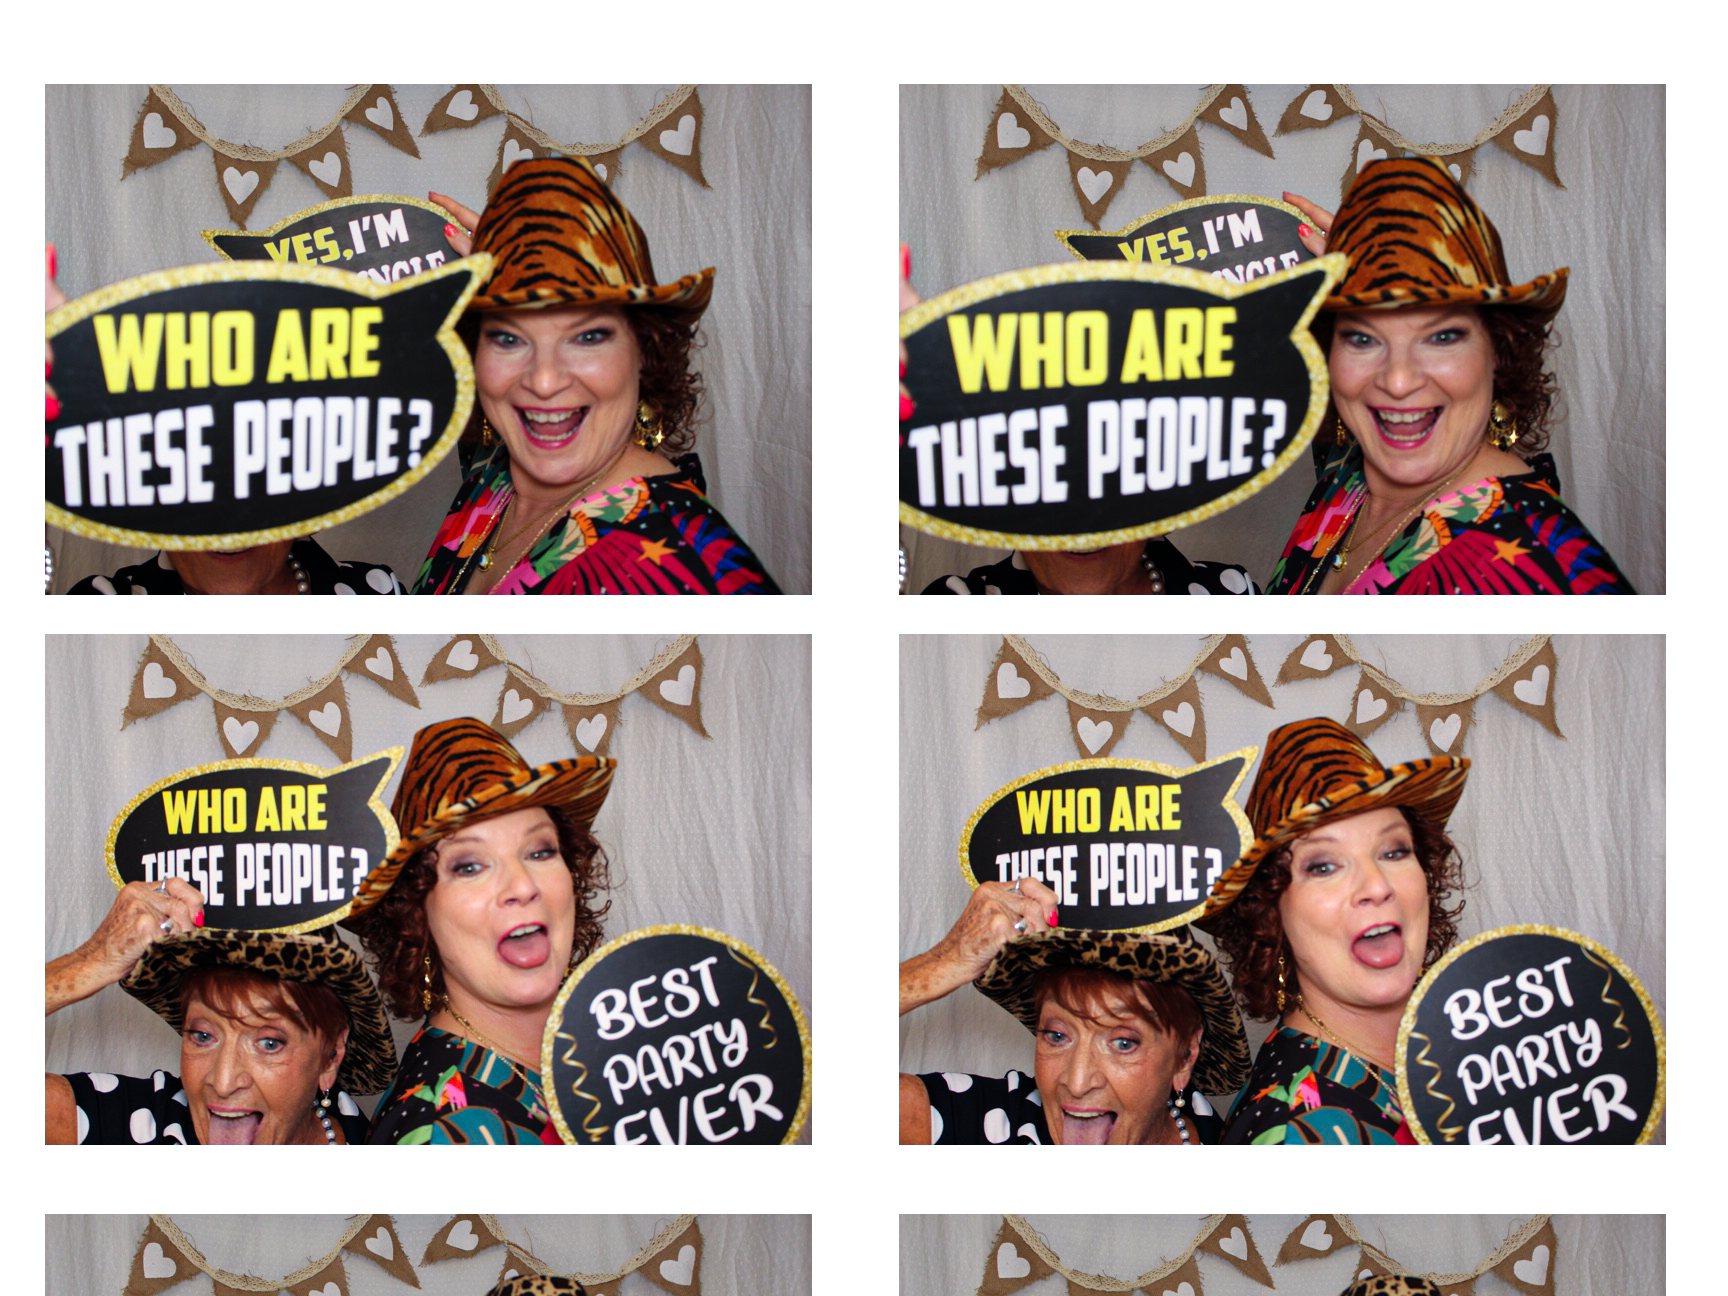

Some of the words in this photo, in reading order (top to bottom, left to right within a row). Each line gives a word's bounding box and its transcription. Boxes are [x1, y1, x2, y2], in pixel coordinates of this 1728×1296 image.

[349, 208, 409, 254] I'M
[1203, 208, 1263, 254] I'M
[93, 310, 254, 393] WHO
[266, 306, 383, 383] ARE
[947, 310, 1108, 393] WHO
[1120, 306, 1237, 383] ARE
[54, 405, 214, 507] THESE
[233, 396, 433, 499] PEOPLE?
[908, 405, 1068, 507] THESE
[1087, 396, 1287, 499] PEOPLE?
[162, 788, 247, 835] WHO
[255, 784, 328, 832] ARE
[1016, 788, 1101, 835] WHO
[1109, 784, 1182, 832] ARE
[236, 843, 368, 906] PEOPLE?
[1090, 843, 1222, 906] PEOPLE?
[589, 956, 720, 1040] BEST
[1443, 956, 1574, 1040] BEST
[603, 1018, 749, 1105] PARTY
[1457, 1018, 1603, 1105] PARTY
[614, 1073, 784, 1145] EVER
[1468, 1073, 1638, 1145] EVER
